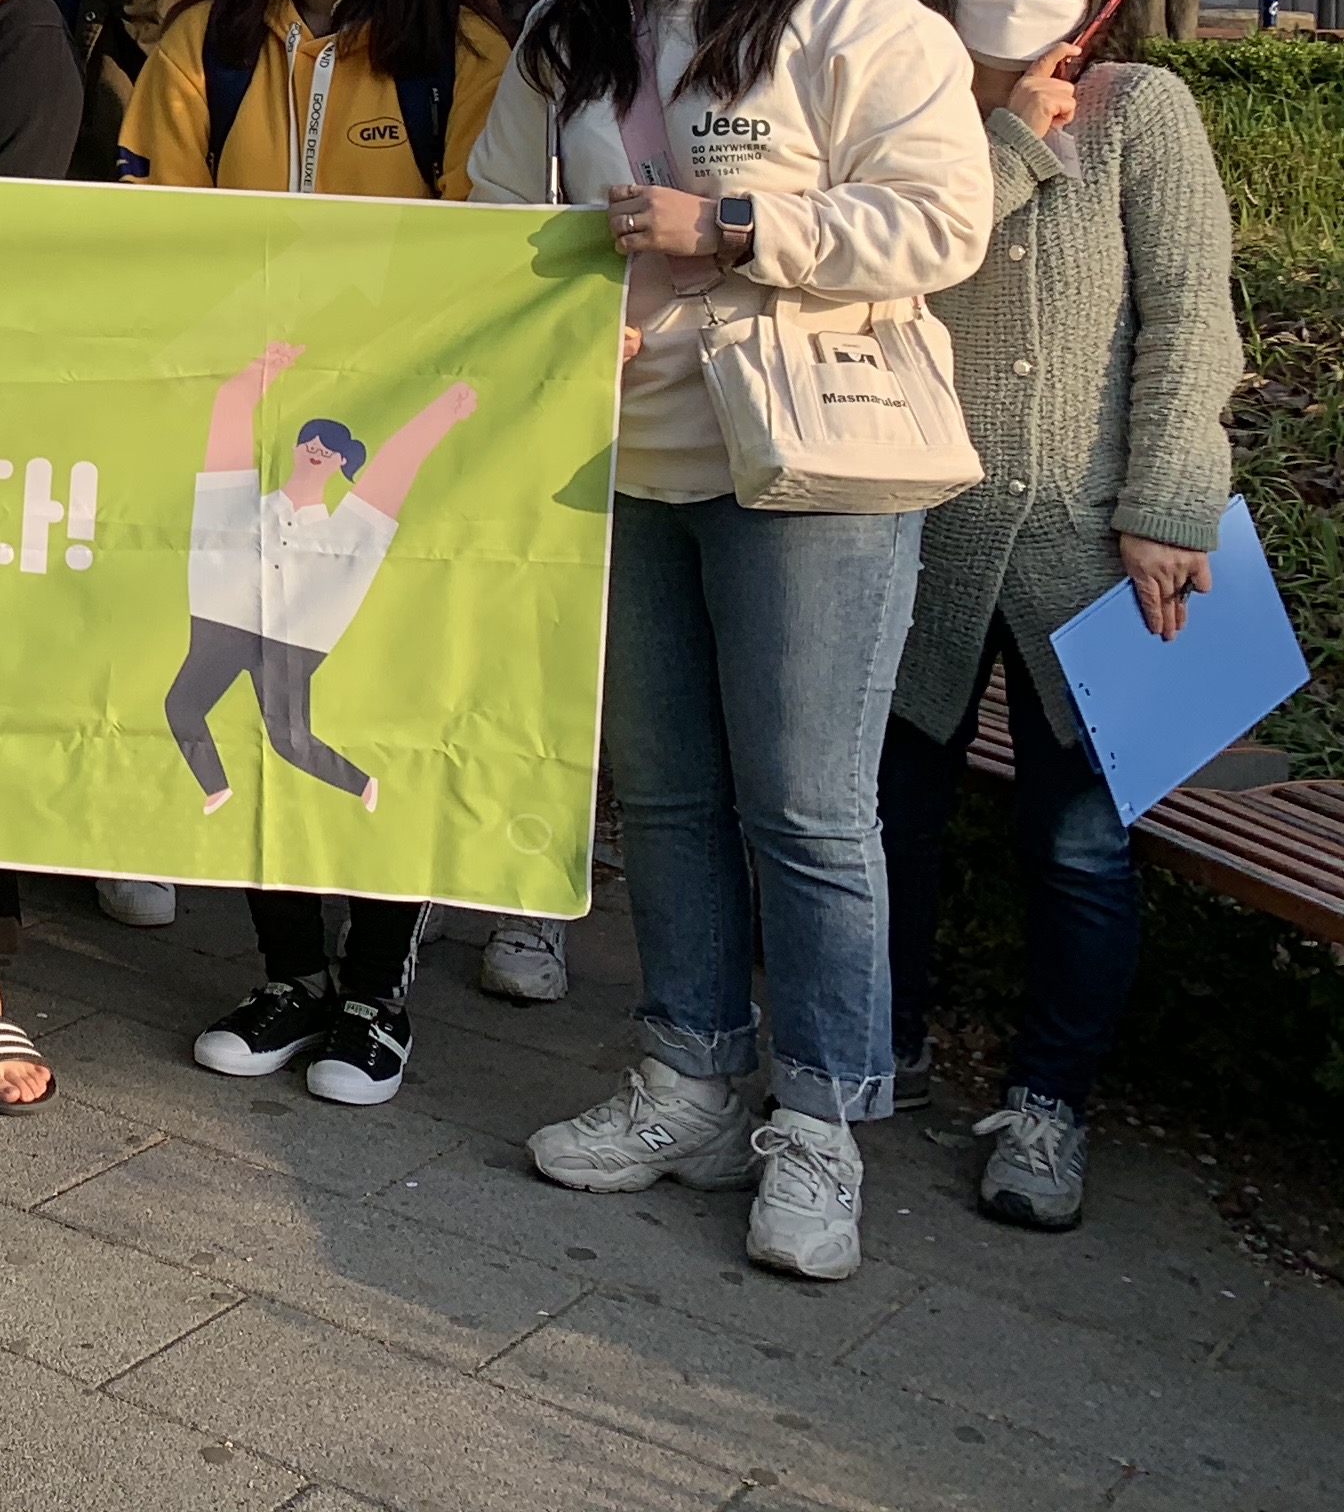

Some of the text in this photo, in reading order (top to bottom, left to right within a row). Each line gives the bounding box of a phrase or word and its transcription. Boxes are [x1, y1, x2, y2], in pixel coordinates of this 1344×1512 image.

[309, 93, 324, 135] GOOSE
[359, 125, 400, 141] GIVE
[691, 111, 771, 141] Jeep
[691, 145, 706, 154] GO
[692, 156, 706, 165] DO
[303, 139, 317, 186] DELUXE
